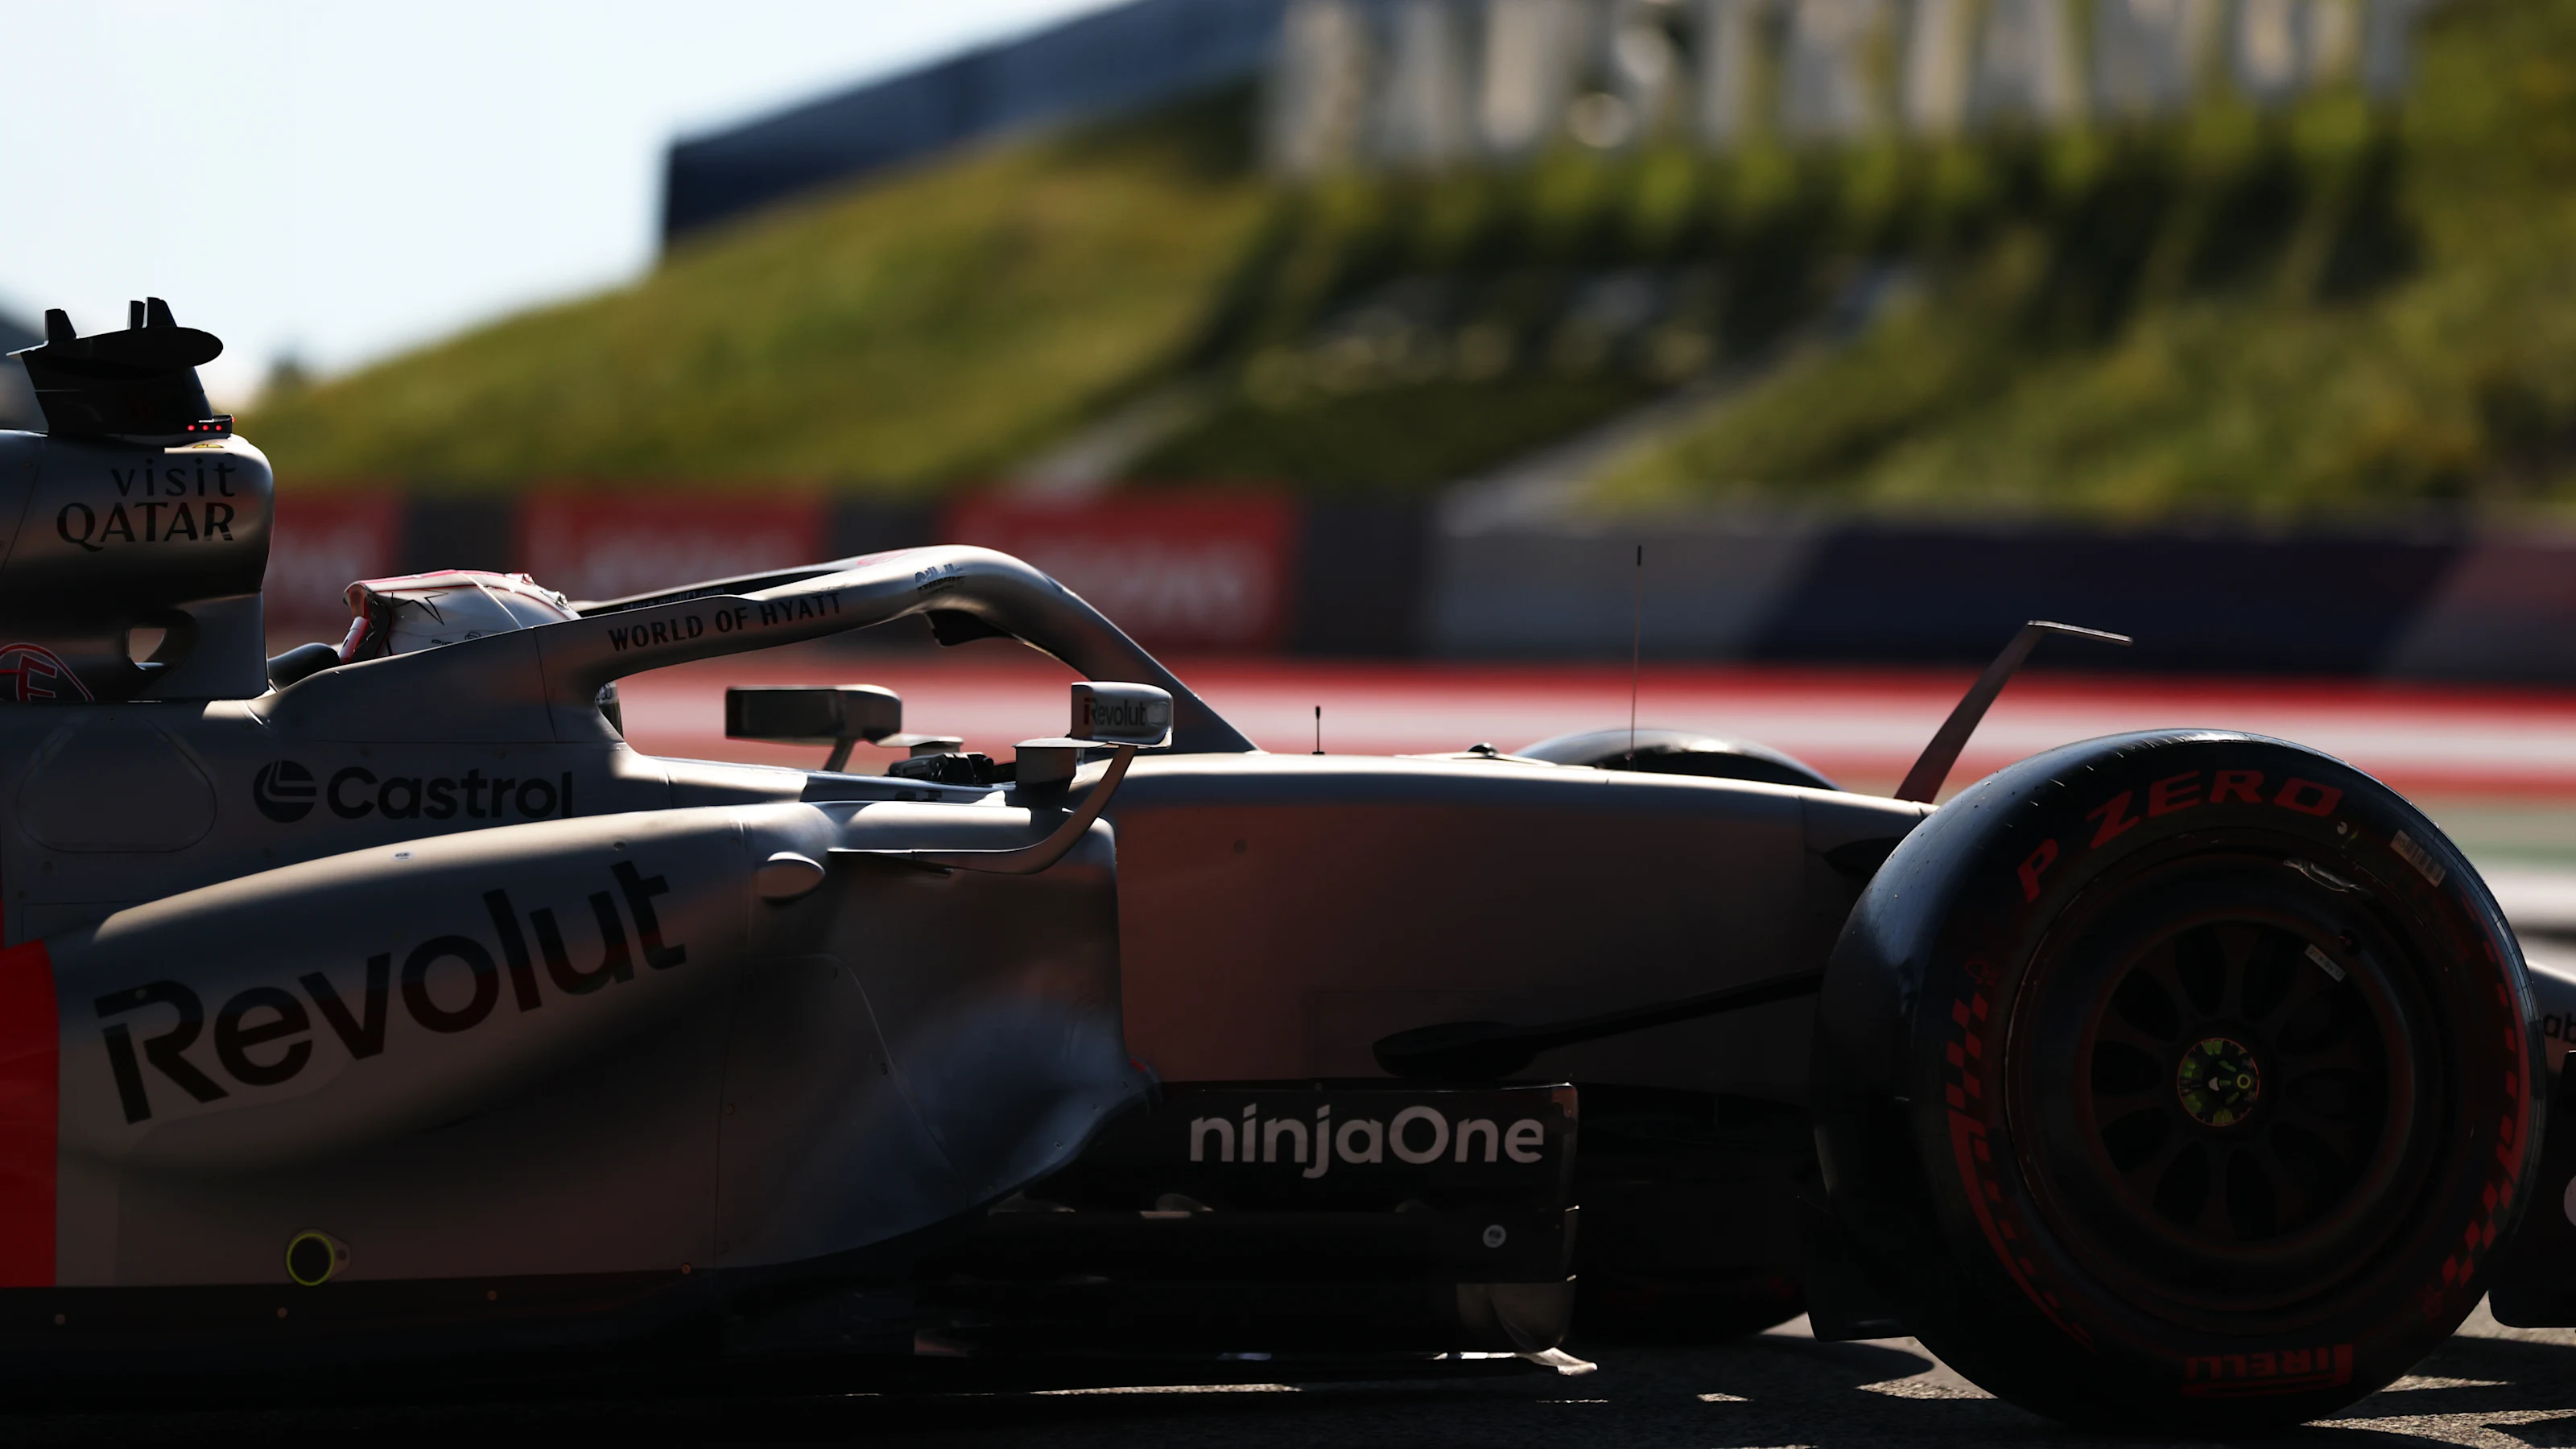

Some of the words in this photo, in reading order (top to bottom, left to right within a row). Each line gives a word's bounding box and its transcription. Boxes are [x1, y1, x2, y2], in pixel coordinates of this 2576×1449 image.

[111, 456, 236, 497] visit
[56, 502, 235, 552] QATAR
[608, 614, 704, 653] WORLD
[715, 605, 749, 633] OF
[762, 592, 841, 626] HYATT
[1083, 697, 1148, 726] Revolut
[327, 766, 573, 819] Castrol
[2016, 837, 2059, 903] P
[2084, 769, 2344, 851] ZERO
[93, 860, 687, 1125] Revolut
[1189, 1102, 1544, 1179] ninjaOne
[2182, 1344, 2354, 1395] PIRELLI
